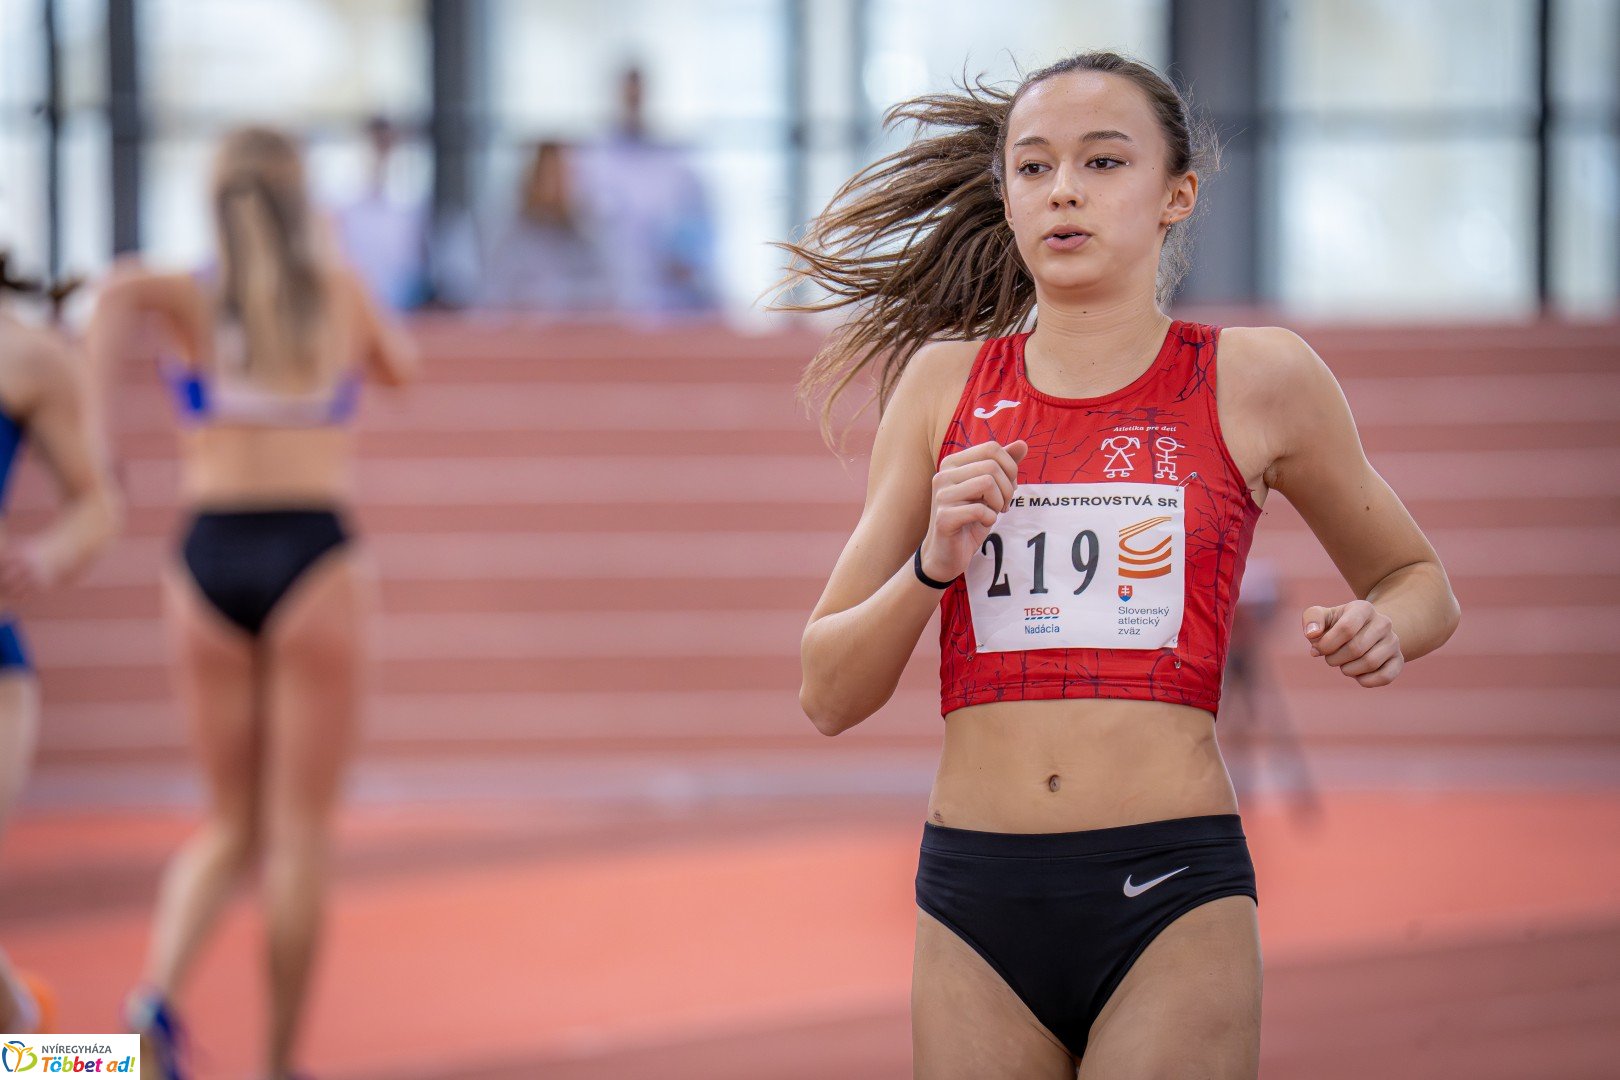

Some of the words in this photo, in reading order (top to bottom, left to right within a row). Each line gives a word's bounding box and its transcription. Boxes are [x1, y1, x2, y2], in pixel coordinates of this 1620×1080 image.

[1029, 495, 1153, 507] MAJSTROVSTVÁ
[1157, 498, 1178, 508] SR
[981, 529, 1100, 598] 219
[1024, 607, 1060, 616] TESCO
[1118, 606, 1170, 617] Slovenský
[1118, 616, 1160, 627] atletický
[1024, 625, 1060, 634] Nadácia
[1118, 627, 1141, 636] zväz
